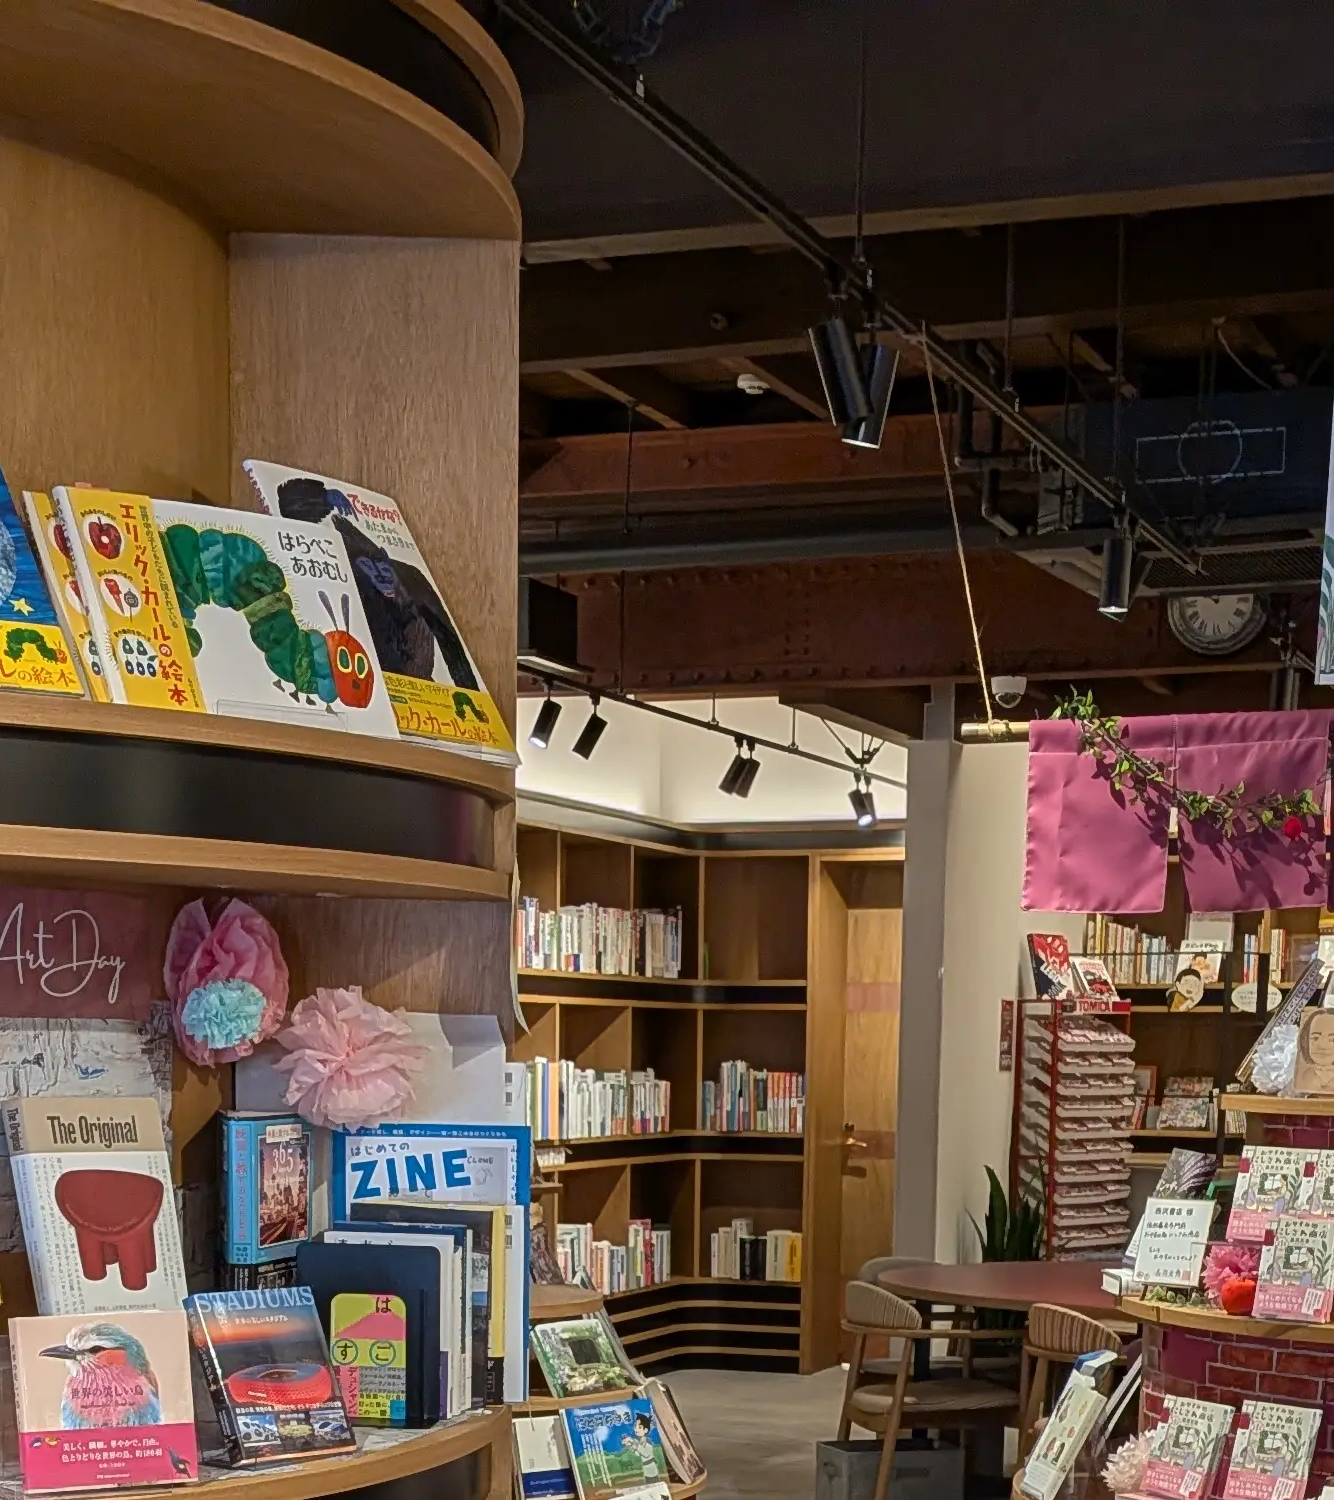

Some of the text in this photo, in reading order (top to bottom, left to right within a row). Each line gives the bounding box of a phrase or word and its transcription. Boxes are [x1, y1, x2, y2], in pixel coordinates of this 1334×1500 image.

[277, 531, 338, 559] はらぺこ
[290, 555, 349, 583] あおむし
[119, 504, 189, 706] エリック・カールの絵本
[7, 1108, 19, 1123] The
[47, 1114, 139, 1149] The Original
[351, 1141, 410, 1157] はじめての
[350, 1149, 472, 1200] ZINE
[195, 1286, 315, 1313] STADIUMS
[376, 1297, 392, 1314] は
[71, 1385, 144, 1400] 世界の美しい鳥
